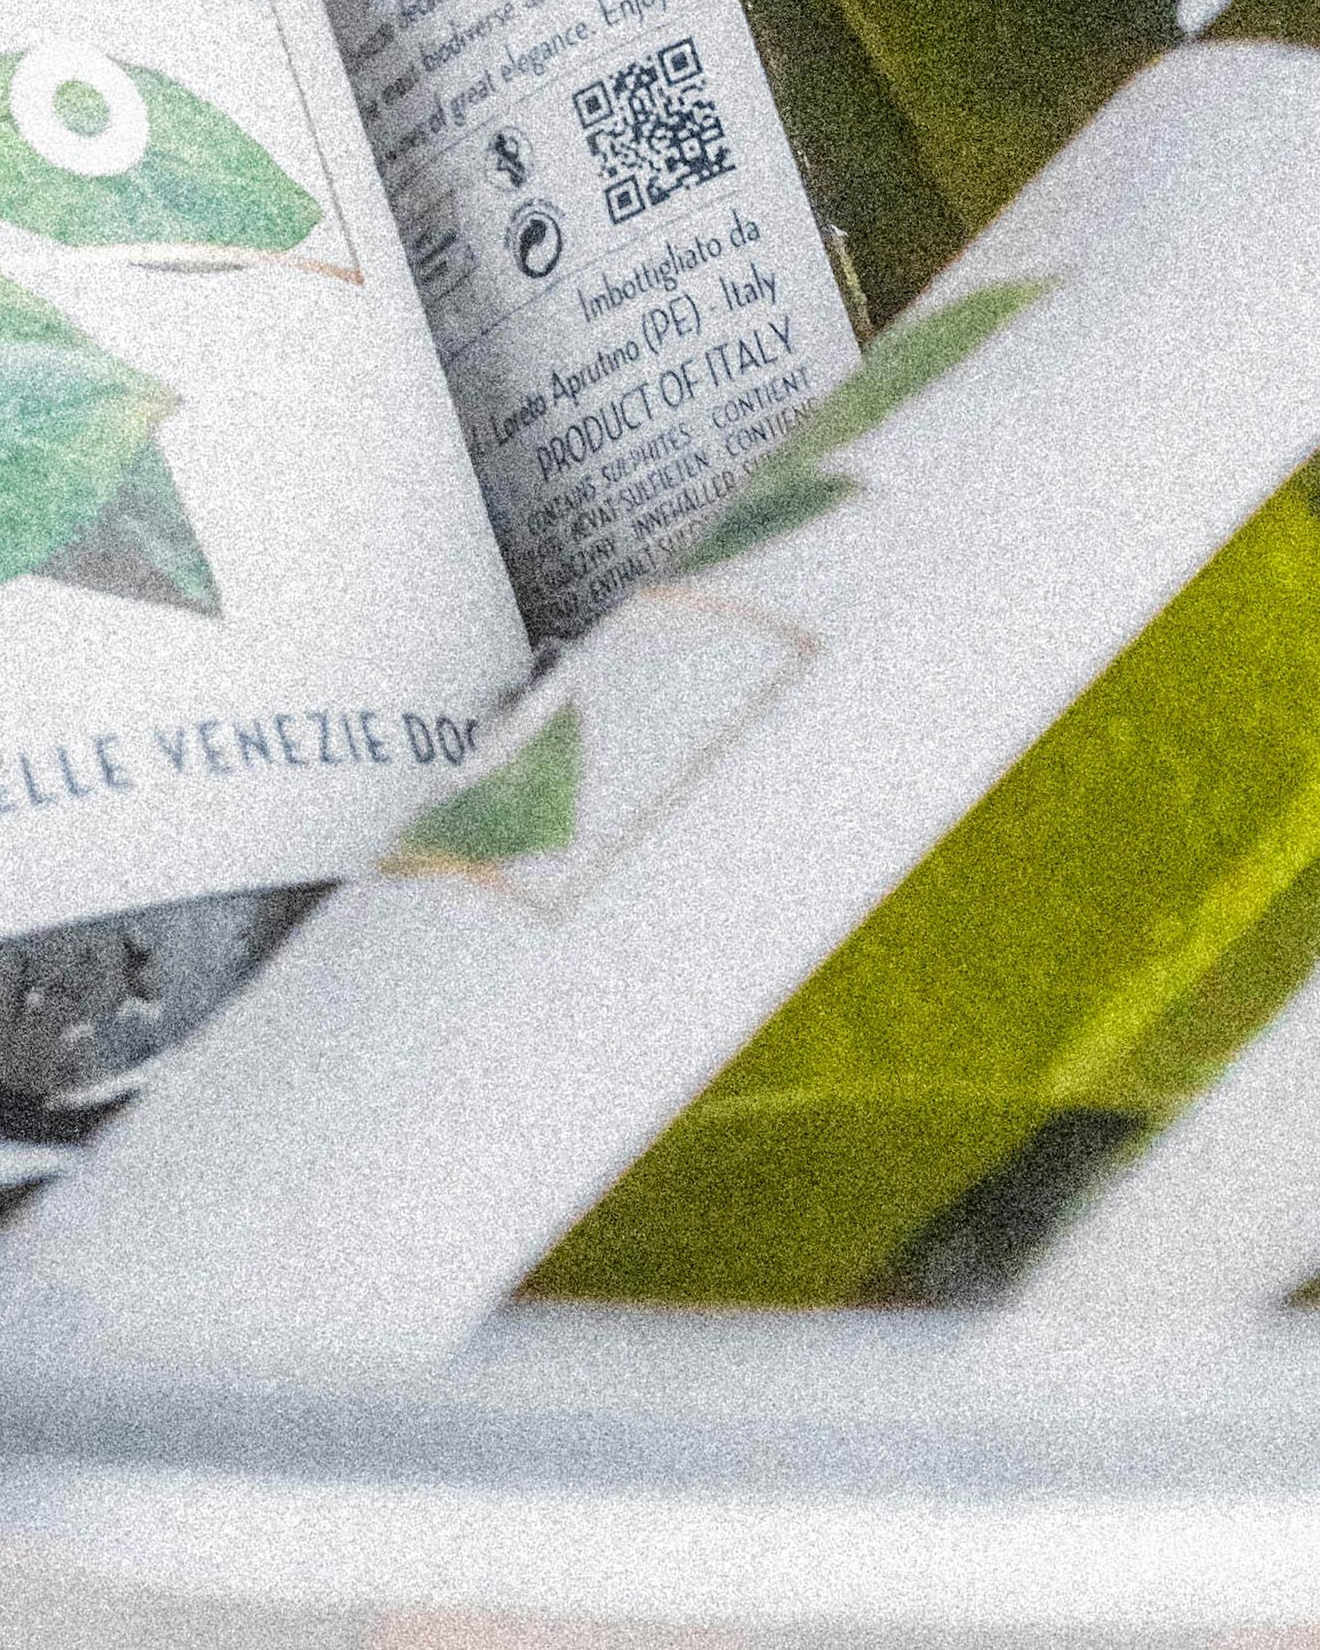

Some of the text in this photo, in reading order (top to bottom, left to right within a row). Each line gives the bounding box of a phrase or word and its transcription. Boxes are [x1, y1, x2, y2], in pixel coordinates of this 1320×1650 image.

[419, 0, 514, 73] biodiverse
[450, 70, 497, 129] great
[577, 208, 761, 323] Imbottigliato da
[490, 392, 547, 447] Loreto
[550, 339, 641, 407] Aprutino
[641, 291, 702, 355] (PE)
[720, 262, 777, 312] Italy
[535, 380, 654, 484] PRODUCT
[660, 359, 702, 410] OF
[705, 315, 797, 387] ITALY
[711, 366, 811, 431] CONTIENT
[153, 709, 393, 774] VENEZIE
